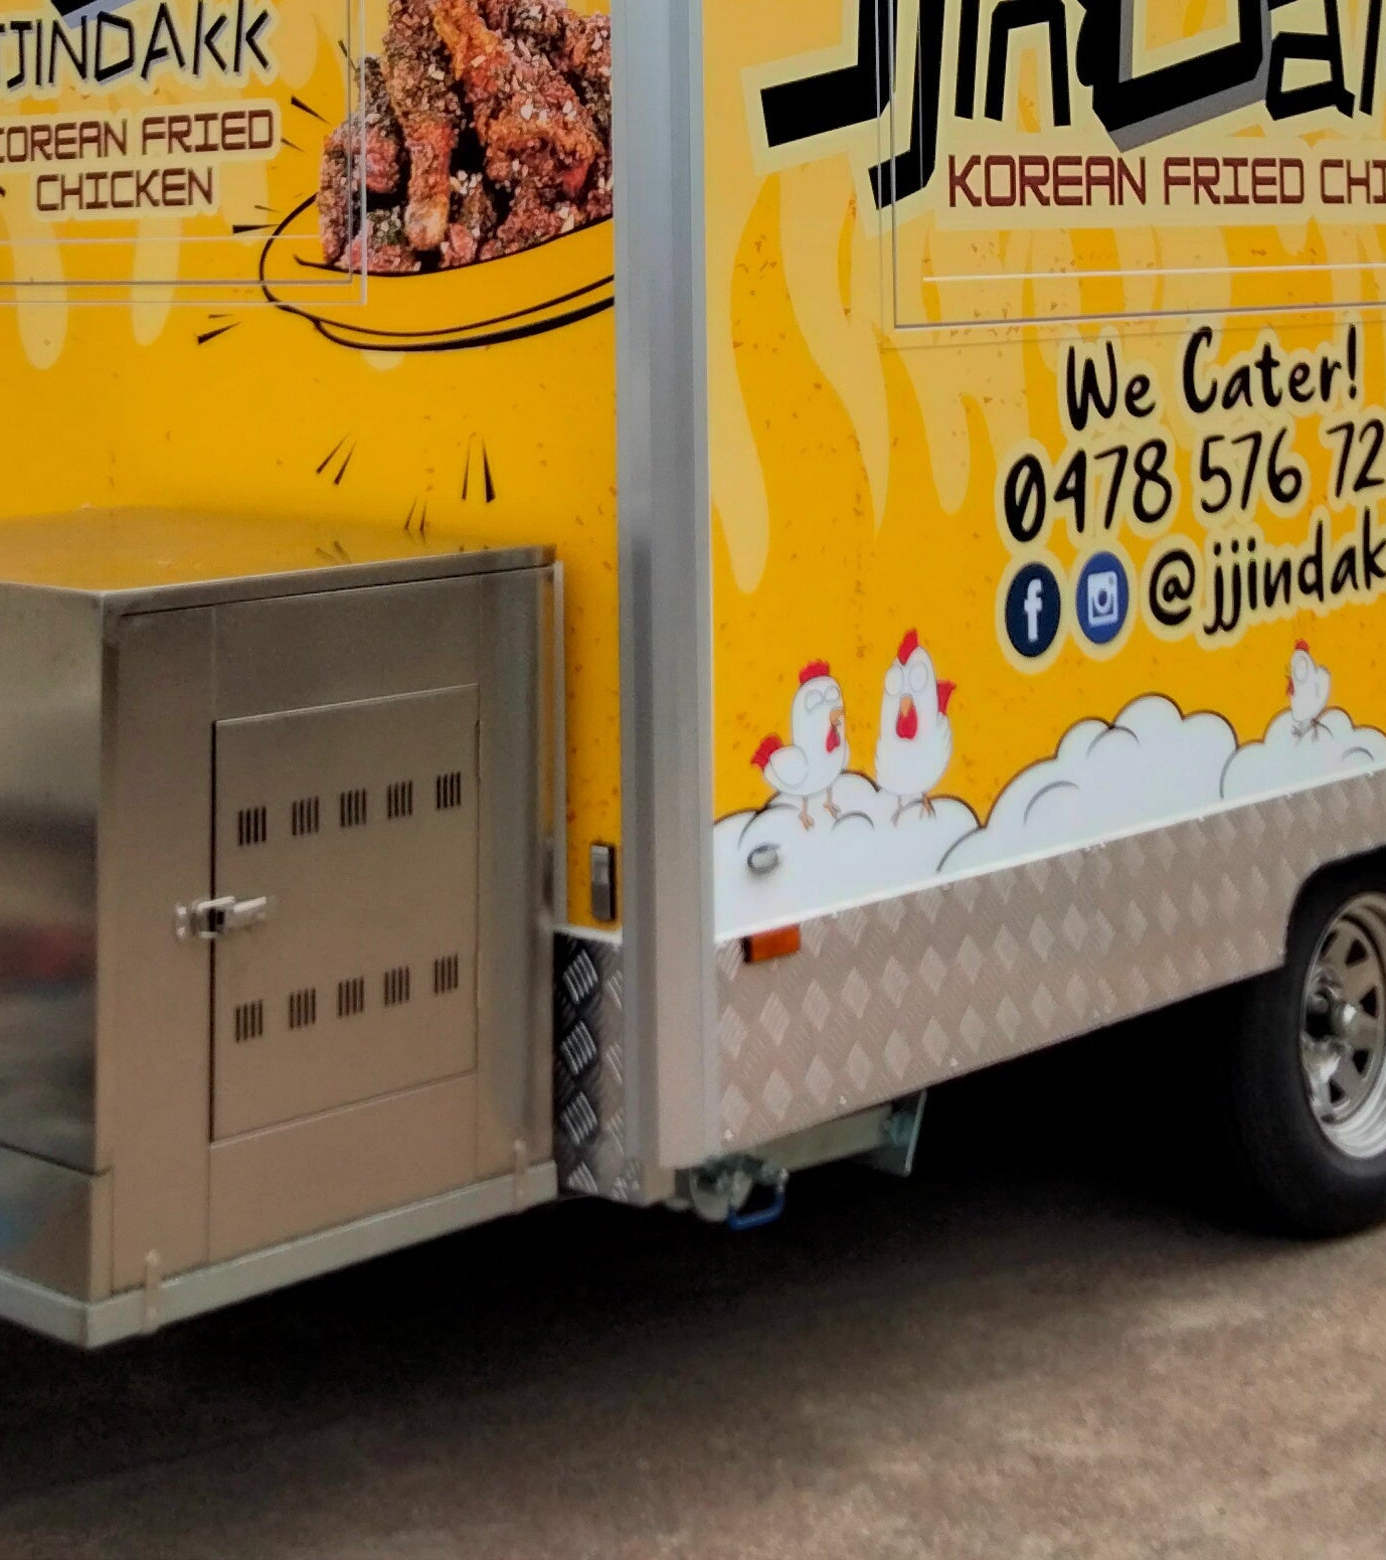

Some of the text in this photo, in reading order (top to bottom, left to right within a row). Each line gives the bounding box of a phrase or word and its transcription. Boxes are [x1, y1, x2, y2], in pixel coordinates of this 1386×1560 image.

[141, 108, 275, 156] FRIED
[36, 166, 213, 213] CHICKEN
[948, 152, 1147, 208] KOREAN
[1163, 154, 1305, 206] FRIED
[1066, 323, 1357, 431] We Cater!
[1003, 438, 1173, 543] 0478
[1200, 427, 1303, 514] 576
